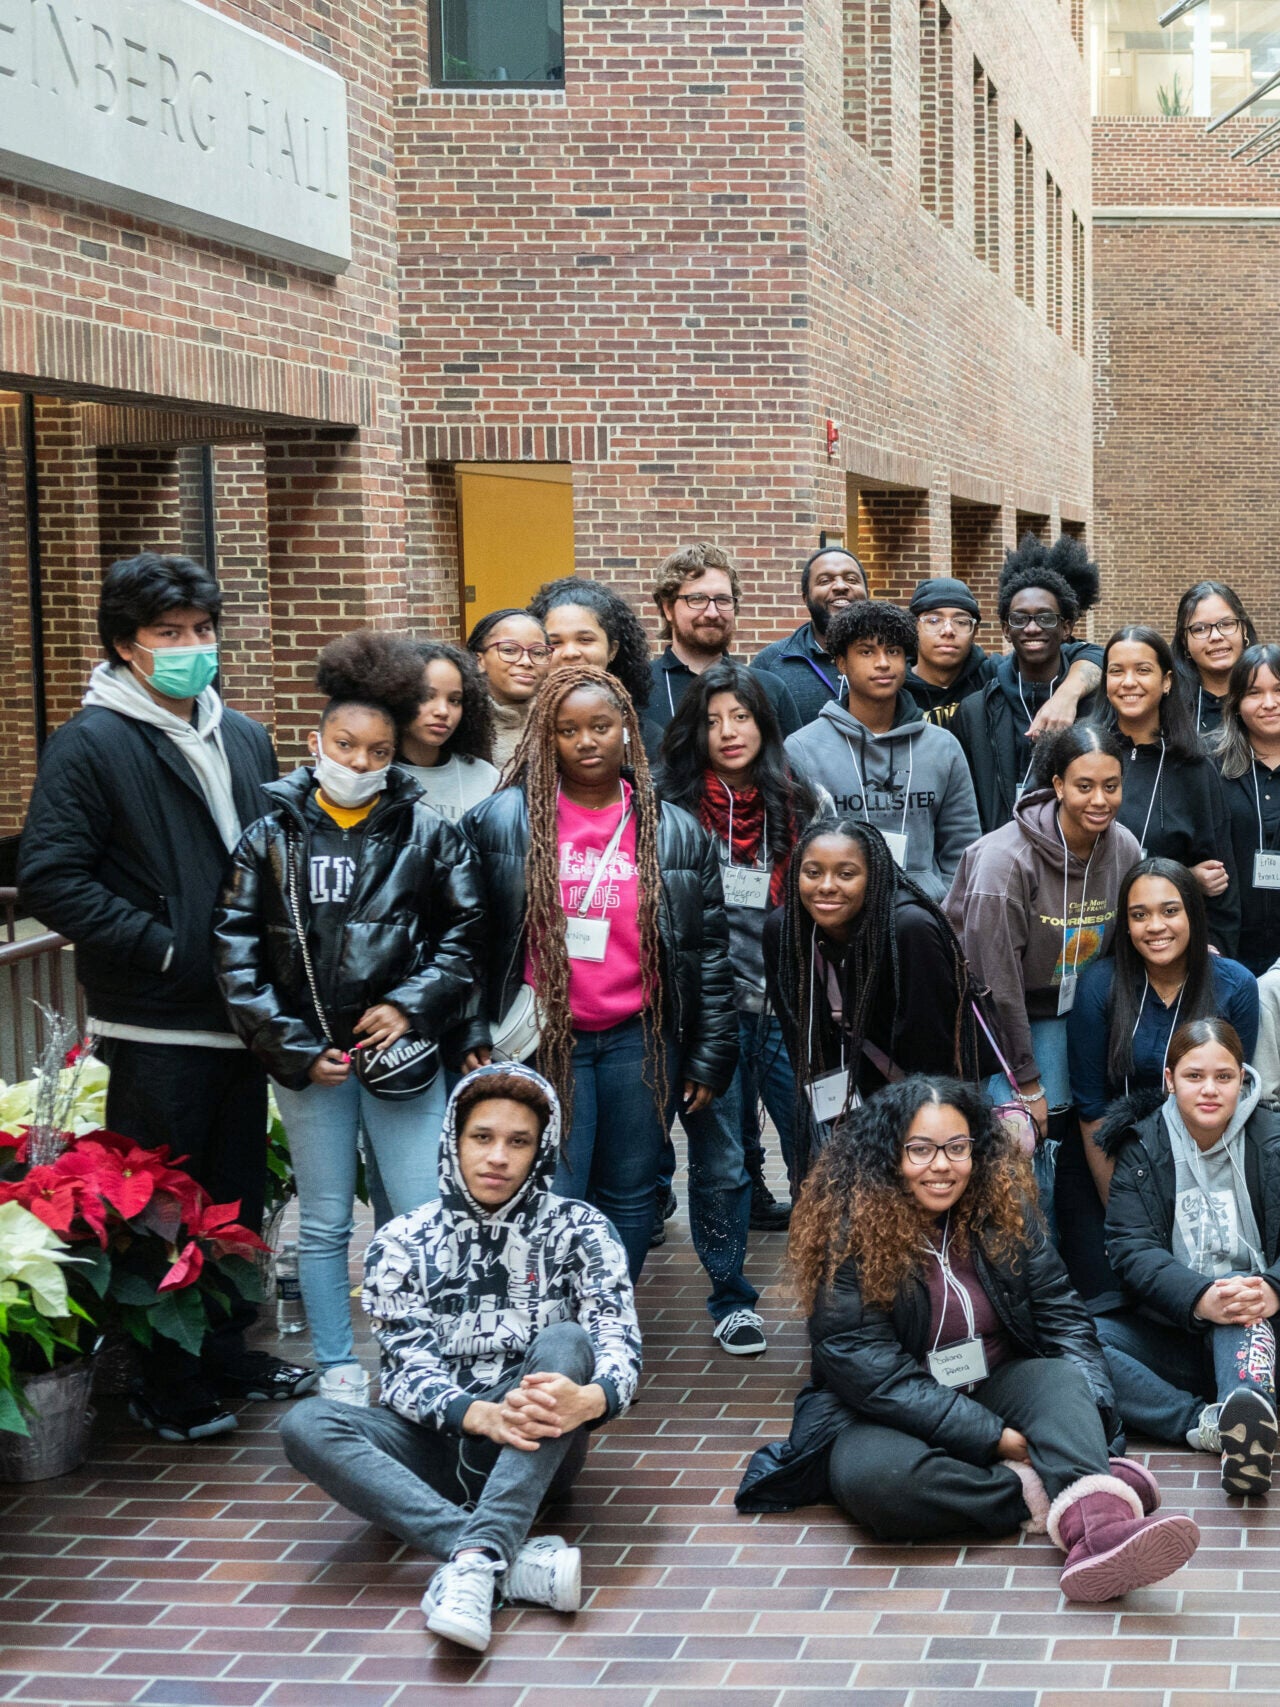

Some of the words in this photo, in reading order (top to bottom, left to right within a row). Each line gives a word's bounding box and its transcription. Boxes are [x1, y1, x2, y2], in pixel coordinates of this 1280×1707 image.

[244, 91, 338, 200] HALL
[834, 791, 936, 811] HOLLISTER
[380, 1038, 432, 1069] Winne
